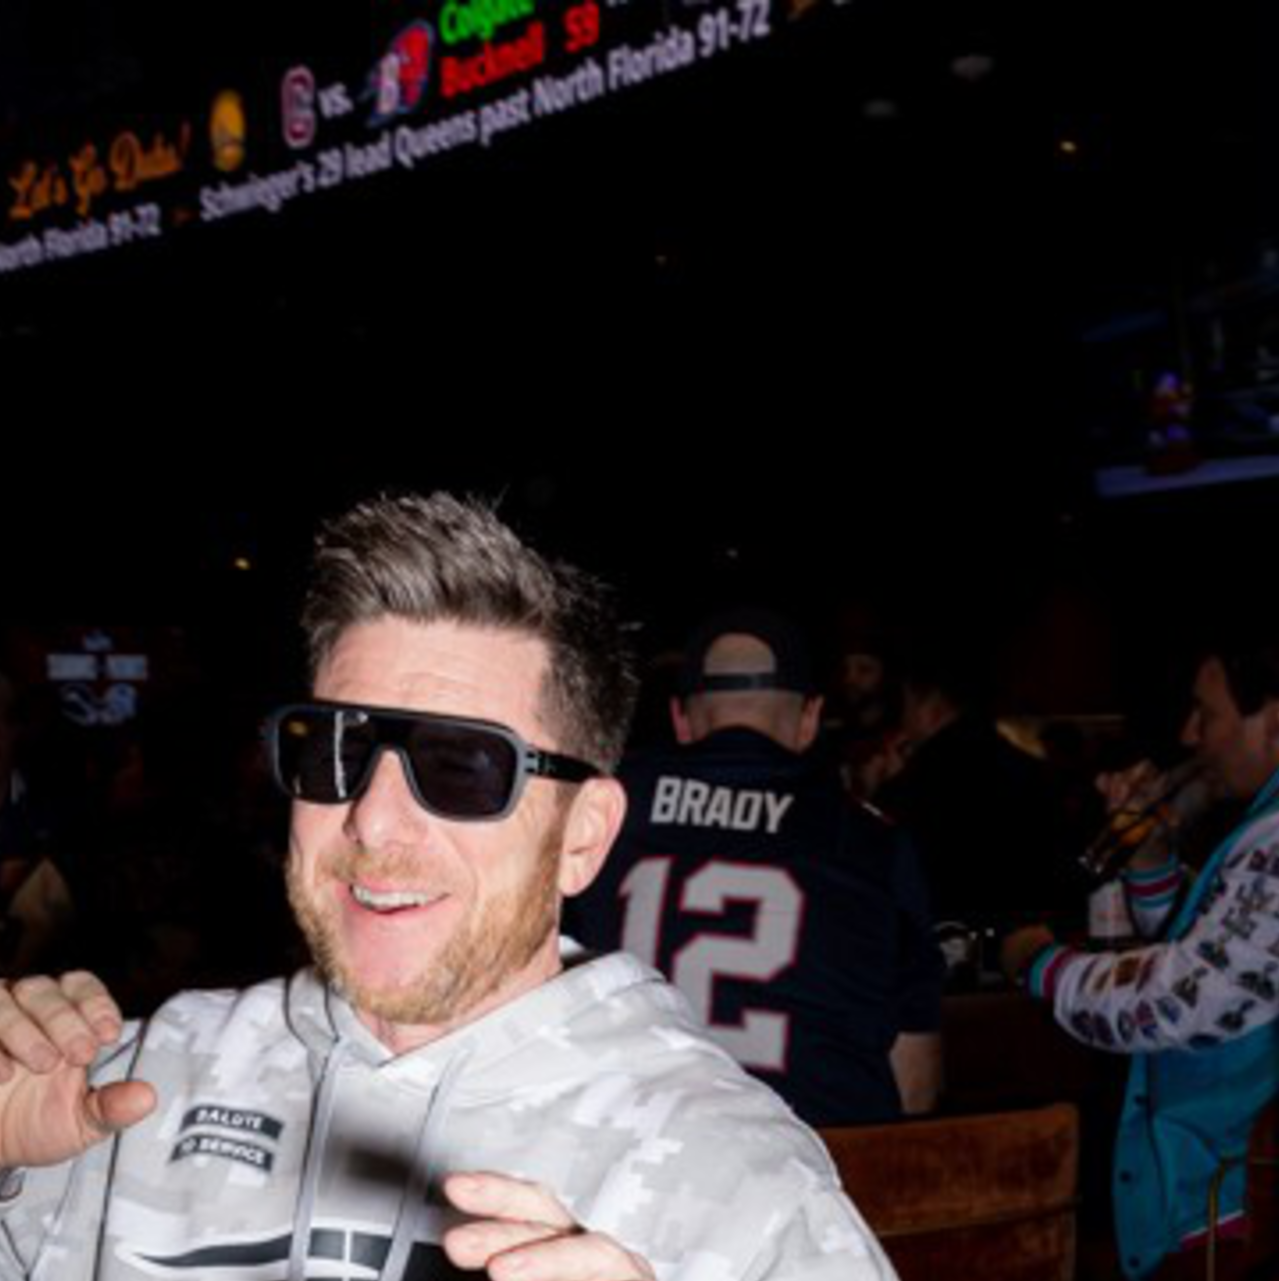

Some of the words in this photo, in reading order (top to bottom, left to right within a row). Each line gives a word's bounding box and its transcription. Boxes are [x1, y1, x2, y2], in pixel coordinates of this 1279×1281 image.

[344, 142, 391, 178] lead
[395, 110, 477, 168] Queens
[480, 86, 531, 146] past
[533, 57, 604, 115] North
[607, 22, 695, 93] Florida
[697, 0, 772, 59] 91-72
[441, 22, 545, 97] Bucknell
[651, 776, 794, 834] BRADY
[618, 854, 805, 1073] 12
[196, 1108, 263, 1130] SALUTE
[199, 1138, 265, 1165] SERVICE
